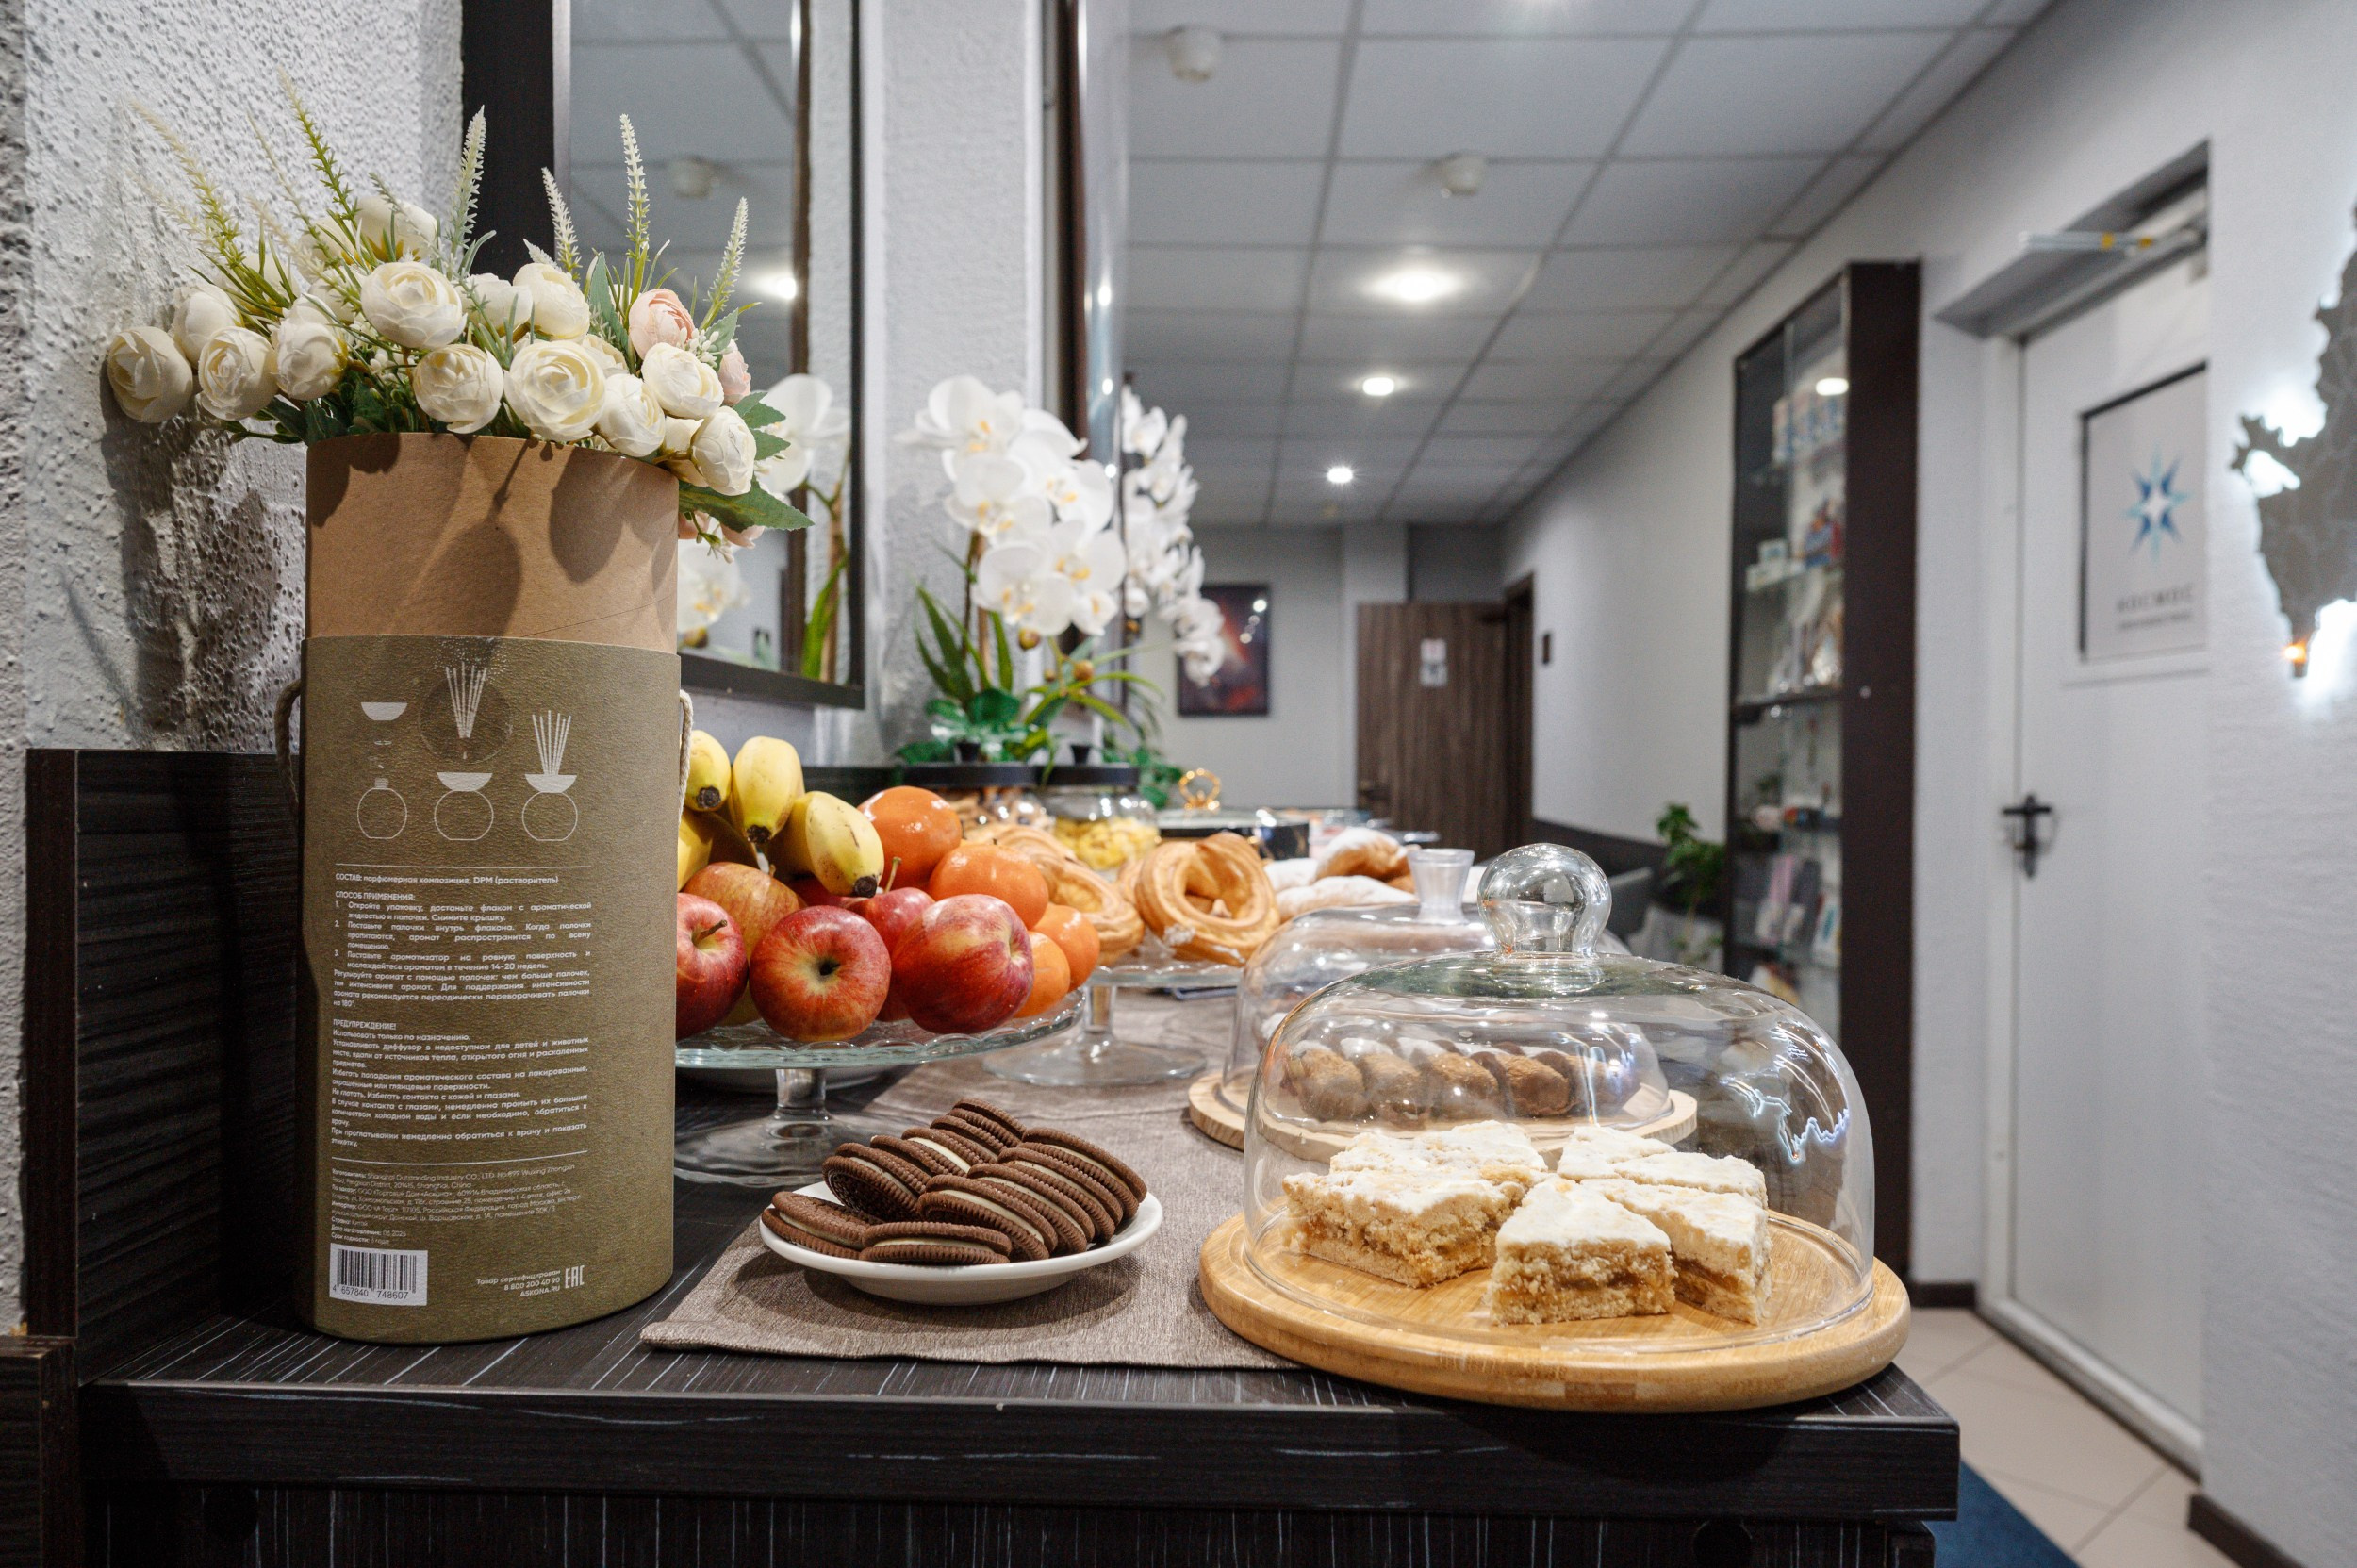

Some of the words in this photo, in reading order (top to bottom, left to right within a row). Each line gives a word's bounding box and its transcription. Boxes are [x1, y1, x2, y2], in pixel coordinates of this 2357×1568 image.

[336, 873, 362, 882] СОСТАВ:
[495, 876, 558, 884] (растворитель)
[364, 892, 415, 900] ПРИМЕНЕНИЯ:
[348, 901, 380, 910] Откройте
[531, 902, 591, 911] ароматической
[348, 921, 382, 930] Поставьте
[348, 933, 395, 941] пропитаются,
[526, 951, 576, 960] поверхность
[334, 969, 372, 979] Регулируйте
[486, 992, 555, 1000] переворачивать
[334, 1019, 396, 1030] ПРЕДУПРЕЖДЕНИЕ!
[333, 1029, 376, 1039] Использовать
[333, 1039, 379, 1049] Устанавливать
[383, 1043, 421, 1051] диффузор
[552, 1037, 588, 1046] животных
[536, 1047, 588, 1058] раскаленных
[333, 1068, 358, 1077] Избегать
[332, 1080, 372, 1088] окрашенные
[502, 1099, 537, 1109] промыть
[554, 1095, 588, 1103] большим
[332, 1109, 371, 1117] количеством
[476, 1111, 529, 1119] необходимо,
[535, 1105, 579, 1115] обратиться
[345, 1130, 398, 1139] проглатывании
[455, 1132, 504, 1141] обратиться
[517, 1129, 541, 1137] врачу
[552, 1123, 586, 1132] показать
[501, 1270, 560, 1282] сертифицирован
[341, 1287, 368, 1296] 657840
[377, 1291, 408, 1299] 748607
[520, 1286, 560, 1296] ASKONA.RU
